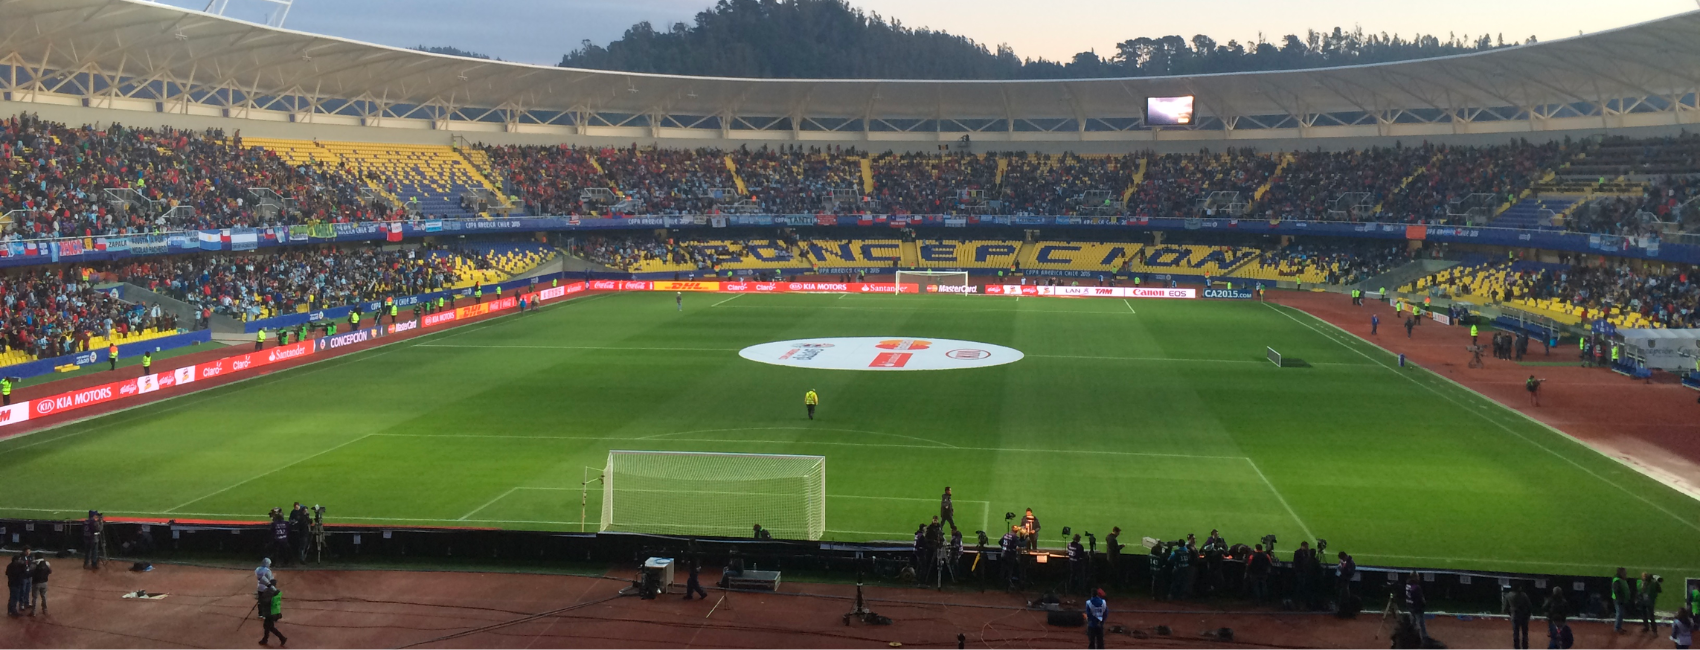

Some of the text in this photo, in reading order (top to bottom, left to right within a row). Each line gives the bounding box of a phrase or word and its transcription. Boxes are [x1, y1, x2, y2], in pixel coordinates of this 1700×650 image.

[463, 305, 481, 317] DHL
[330, 330, 368, 348] CONCEPCIÓN
[276, 345, 305, 360] Santander
[233, 360, 249, 370] Claro
[203, 367, 219, 377] Claro
[56, 387, 112, 409] KIA MOTORS
[40, 402, 52, 411] KIA
